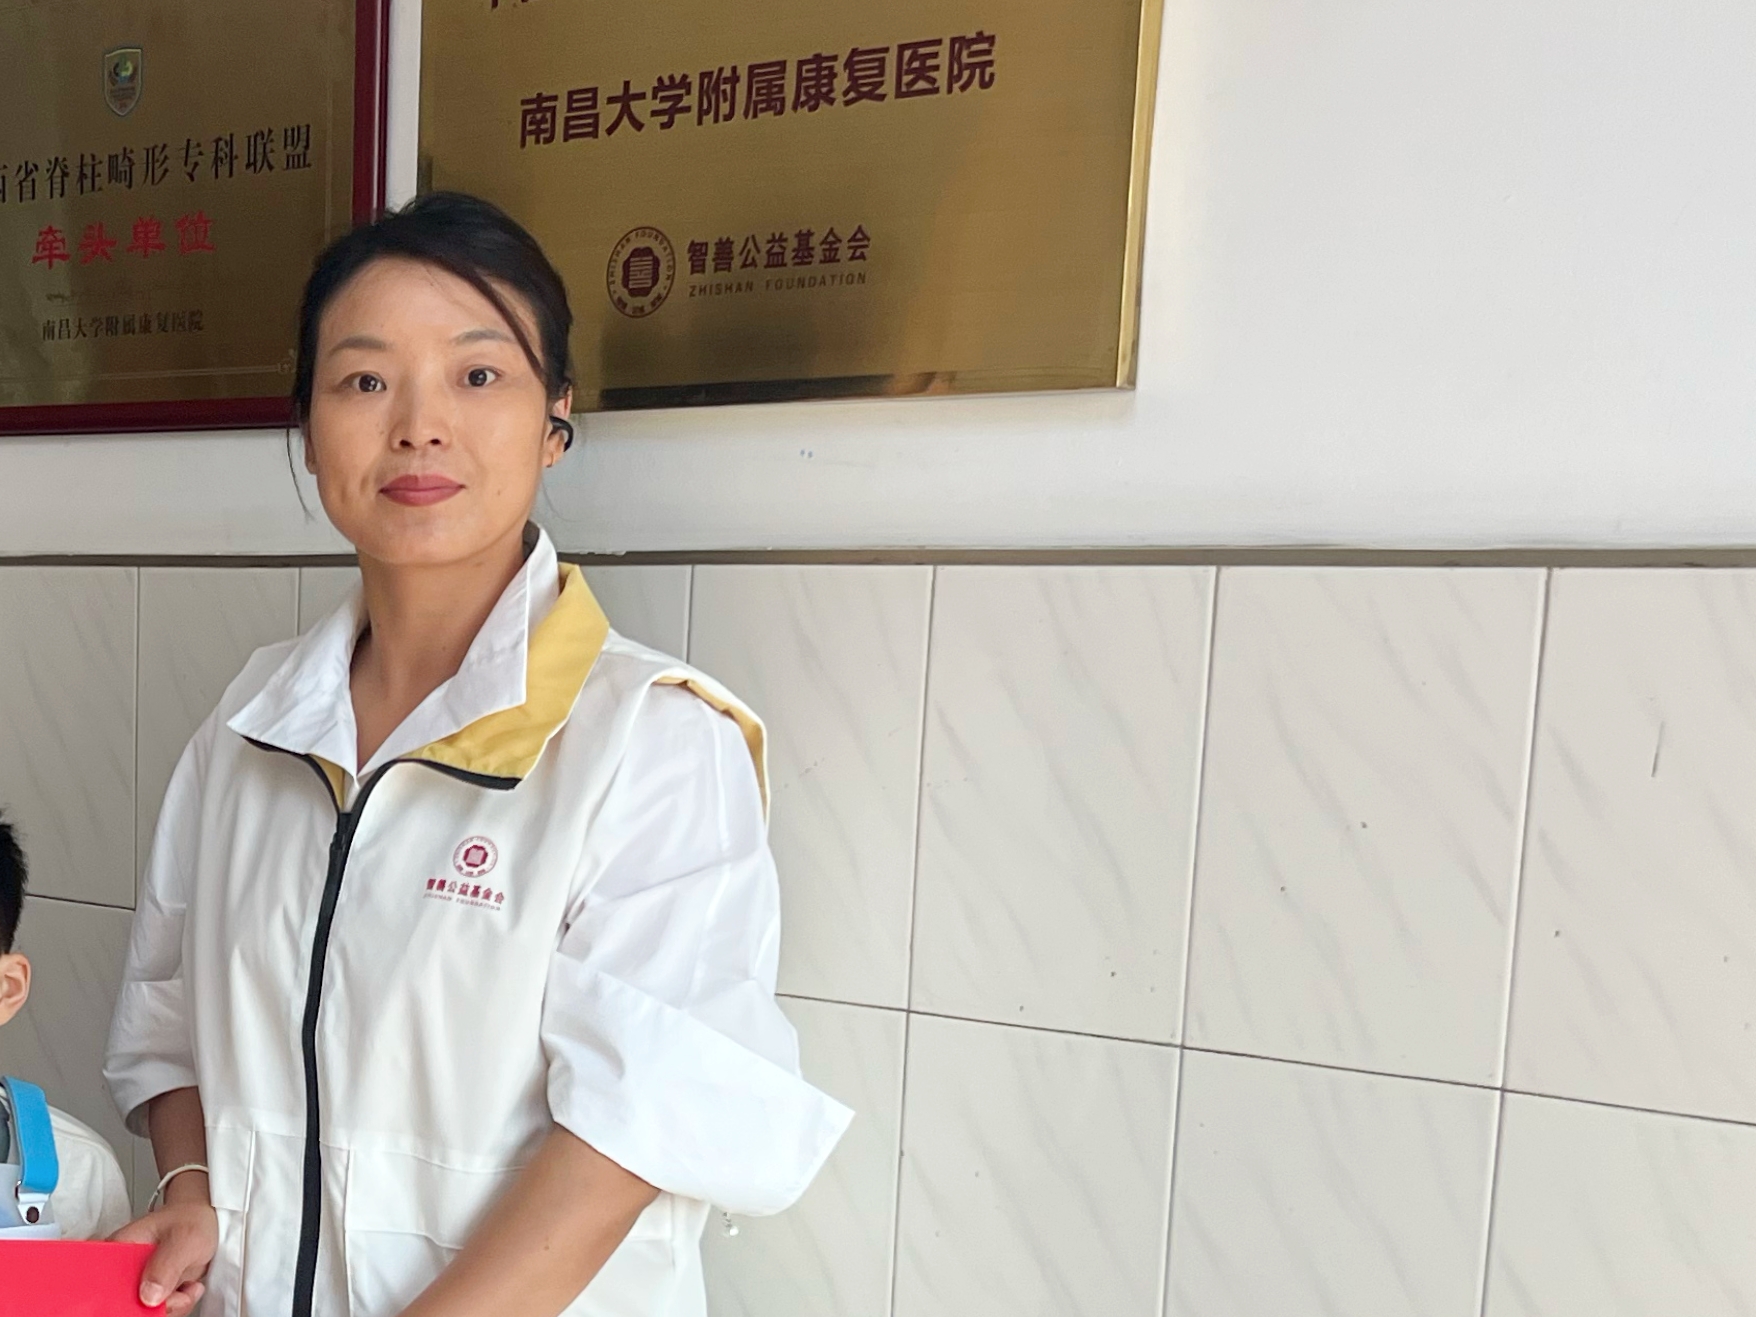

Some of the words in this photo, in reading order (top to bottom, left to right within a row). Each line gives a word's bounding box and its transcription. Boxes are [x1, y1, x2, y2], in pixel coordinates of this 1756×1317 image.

[517, 31, 998, 149] 南昌大学附属康复医院
[30, 210, 217, 269] 牵头单位
[686, 223, 872, 277] 智善公益基金会
[687, 281, 755, 298] ZHISHAN
[764, 271, 868, 292] FOUNDATION
